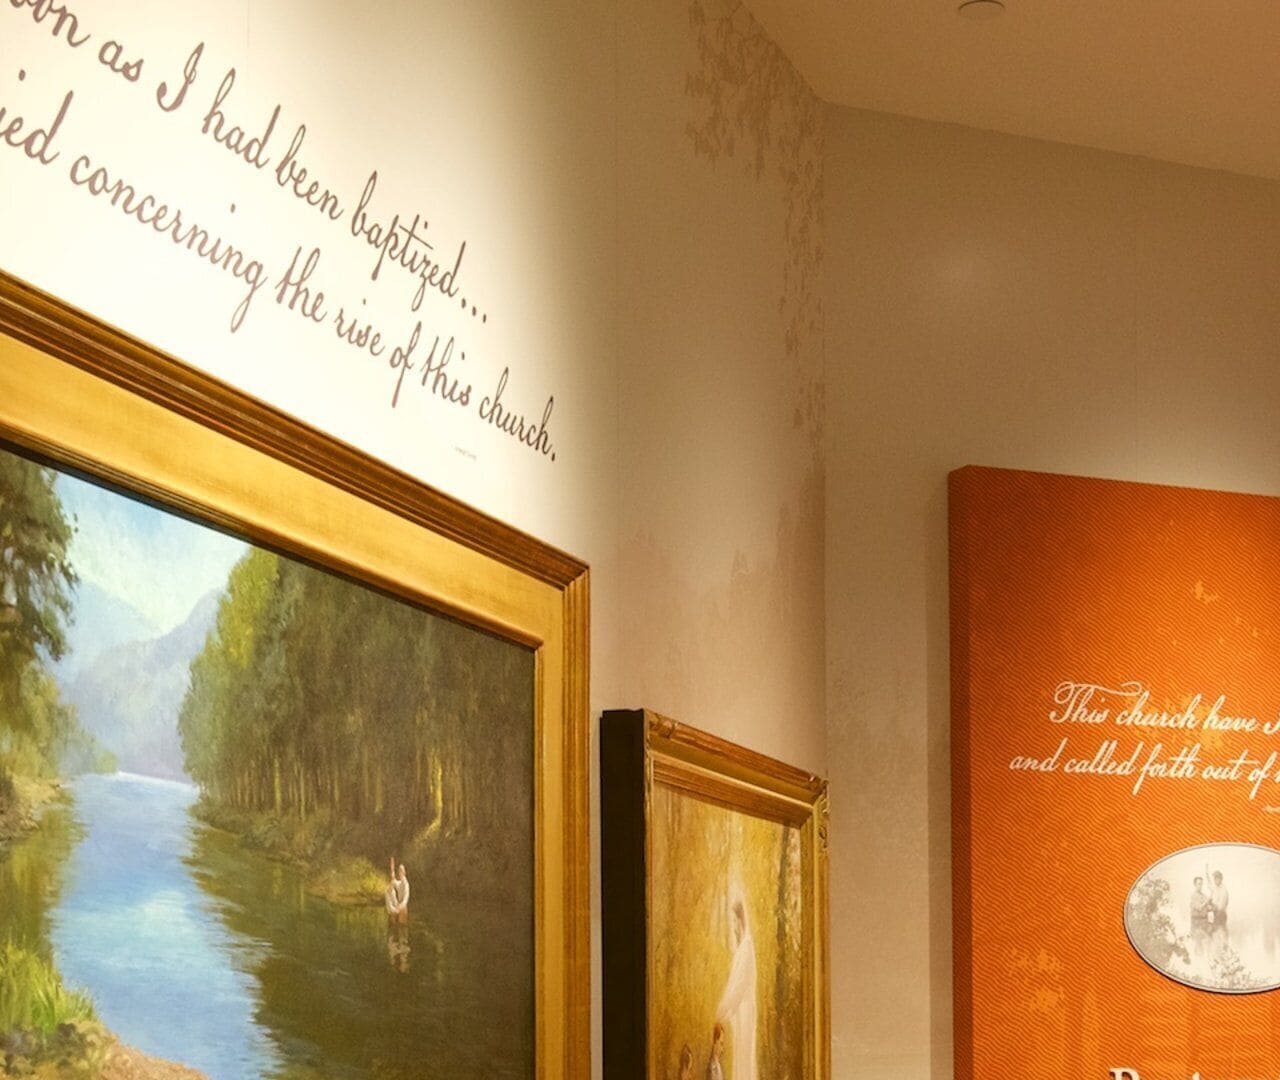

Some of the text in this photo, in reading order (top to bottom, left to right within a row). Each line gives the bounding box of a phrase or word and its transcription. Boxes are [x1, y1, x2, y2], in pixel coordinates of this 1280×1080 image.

[98, 40, 144, 82] as
[156, 42, 204, 112] I
[202, 67, 281, 169] had
[275, 124, 344, 220] been
[69, 155, 269, 333] concerning
[275, 246, 327, 322] the
[335, 298, 386, 356] rise
[390, 321, 422, 409] of
[421, 336, 472, 406] this
[479, 366, 556, 462] church.
[1048, 680, 1142, 723] This
[1116, 690, 1202, 729] church
[1202, 694, 1260, 731] have
[1009, 737, 1068, 772] and
[1064, 740, 1145, 776] called
[1132, 742, 1201, 796] forth
[1202, 749, 1260, 781] out
[1247, 751, 1277, 800] of
